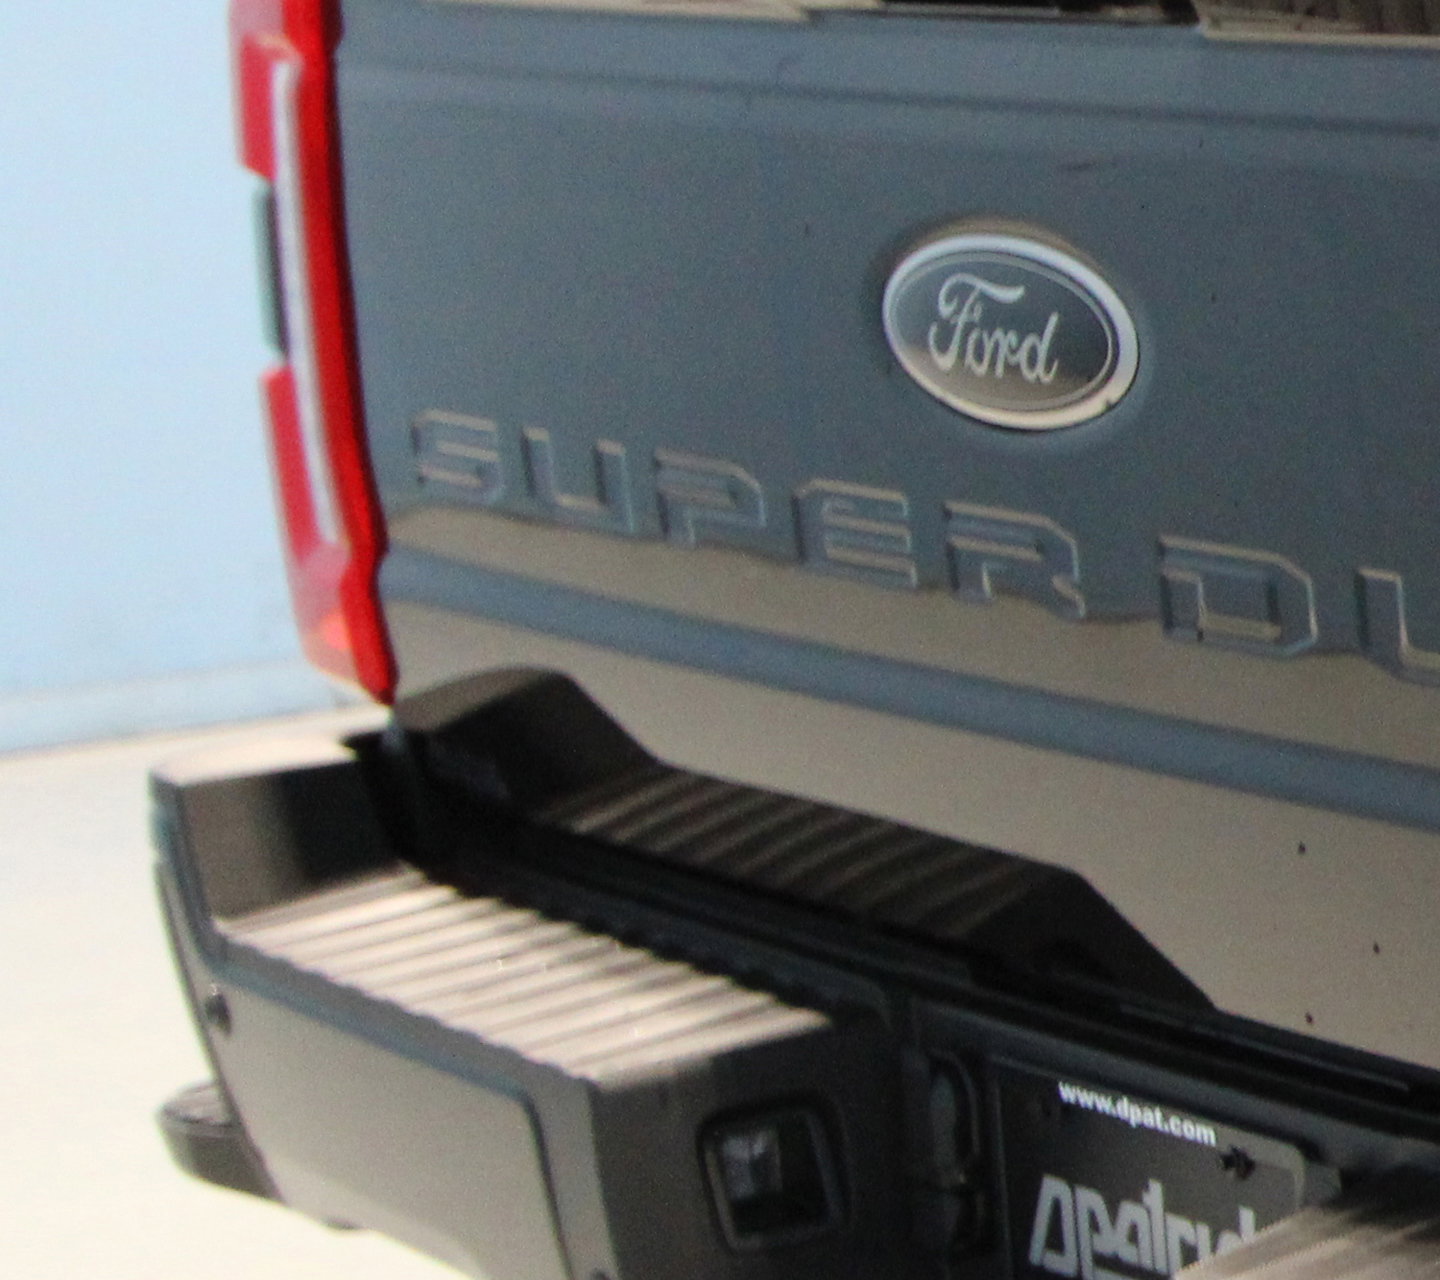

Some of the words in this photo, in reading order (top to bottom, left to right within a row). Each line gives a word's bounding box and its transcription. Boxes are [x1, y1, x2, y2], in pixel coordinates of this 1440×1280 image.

[928, 273, 1059, 384] Ford
[411, 409, 1086, 620] SUPER
[1058, 1081, 1217, 1146] www.dpat.com
